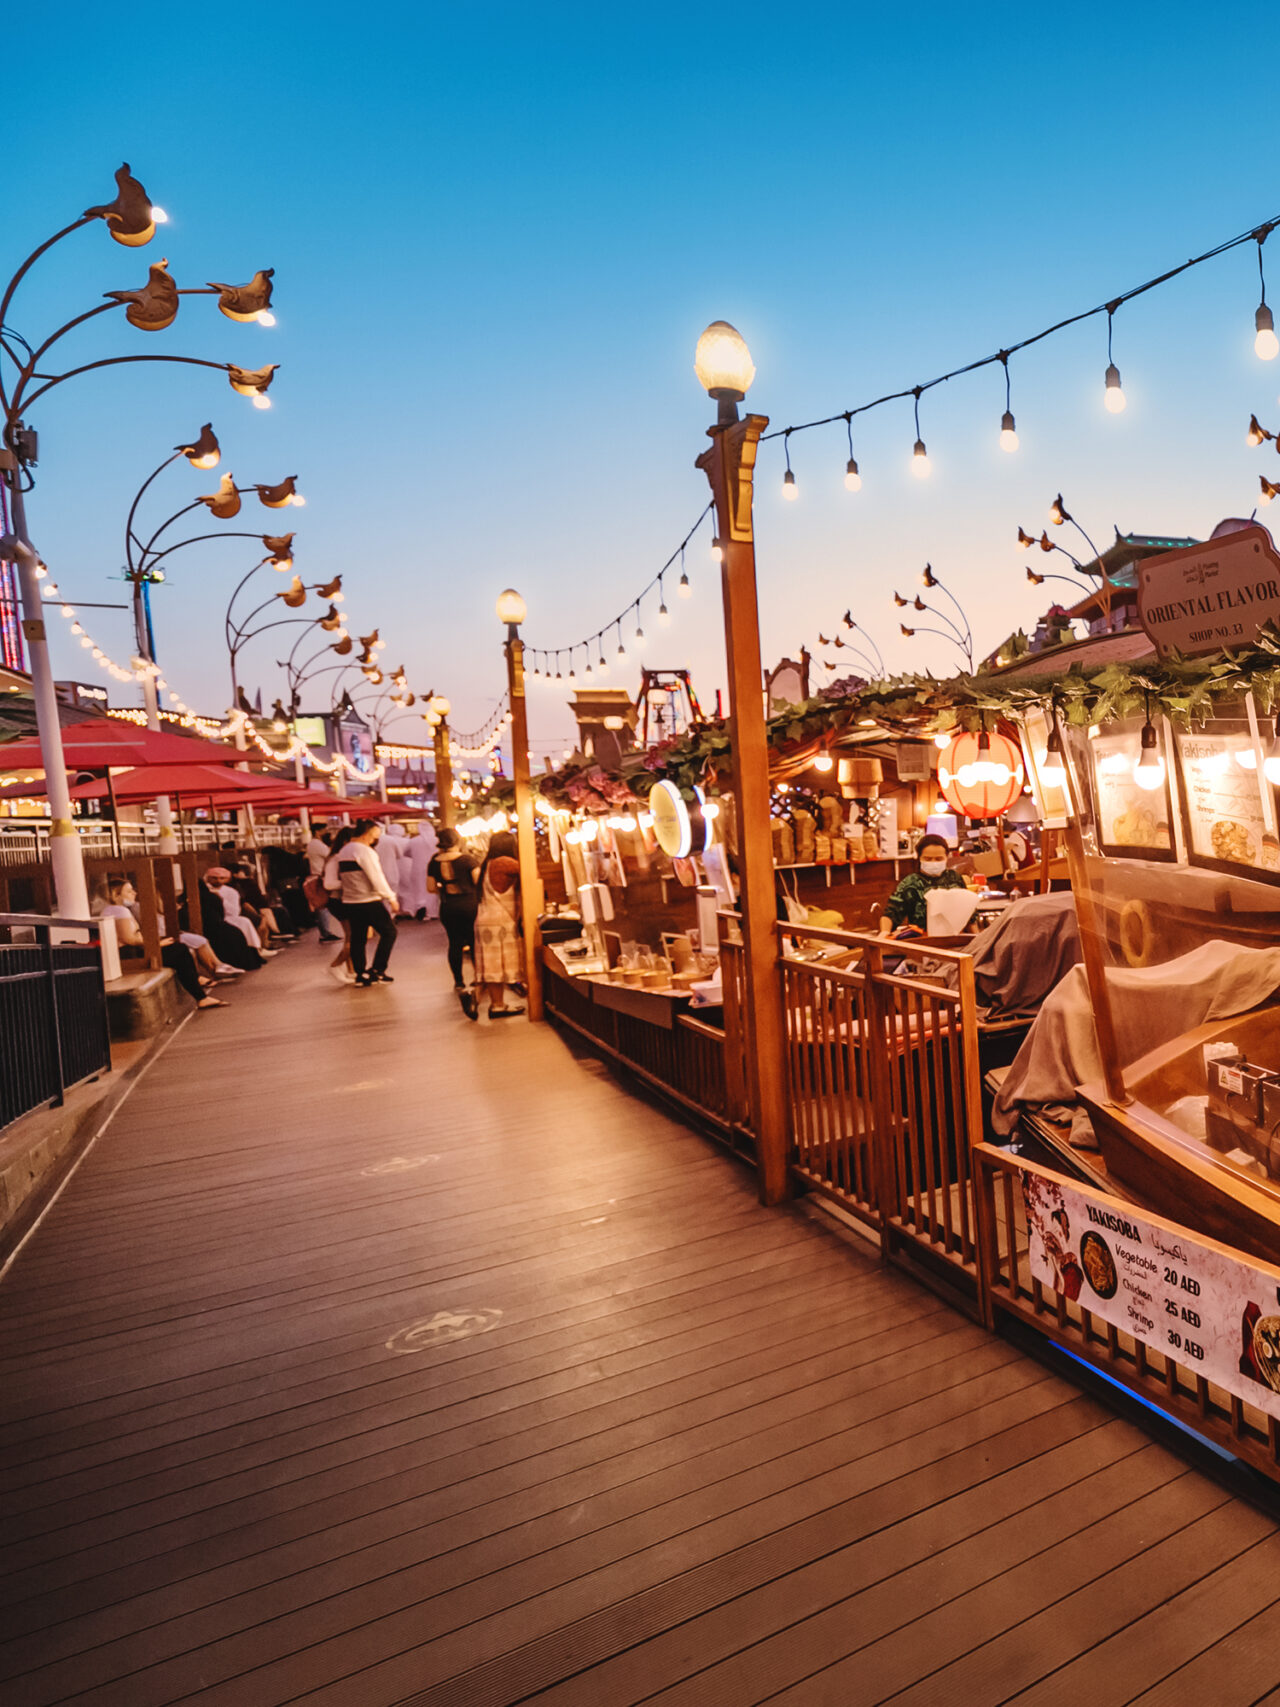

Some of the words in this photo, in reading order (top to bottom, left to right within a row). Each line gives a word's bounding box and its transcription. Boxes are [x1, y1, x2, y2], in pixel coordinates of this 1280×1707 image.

[1147, 594, 1215, 625] ORIENTAL
[1217, 580, 1280, 610] FLAVOR
[1189, 629, 1213, 643] SHOP
[1215, 626, 1231, 639] NO.
[1233, 623, 1244, 635] 33
[1086, 1204, 1142, 1244] YAKISOBA
[1115, 1243, 1158, 1273] Vegetable
[1164, 1267, 1178, 1286] 20
[1181, 1275, 1200, 1296] AED
[1123, 1278, 1153, 1302] Chicken
[1164, 1299, 1178, 1317] 25
[1181, 1307, 1201, 1328] AED
[1127, 1306, 1154, 1330] Shrimp
[1168, 1329, 1181, 1348] 30
[1184, 1339, 1204, 1360] AED
